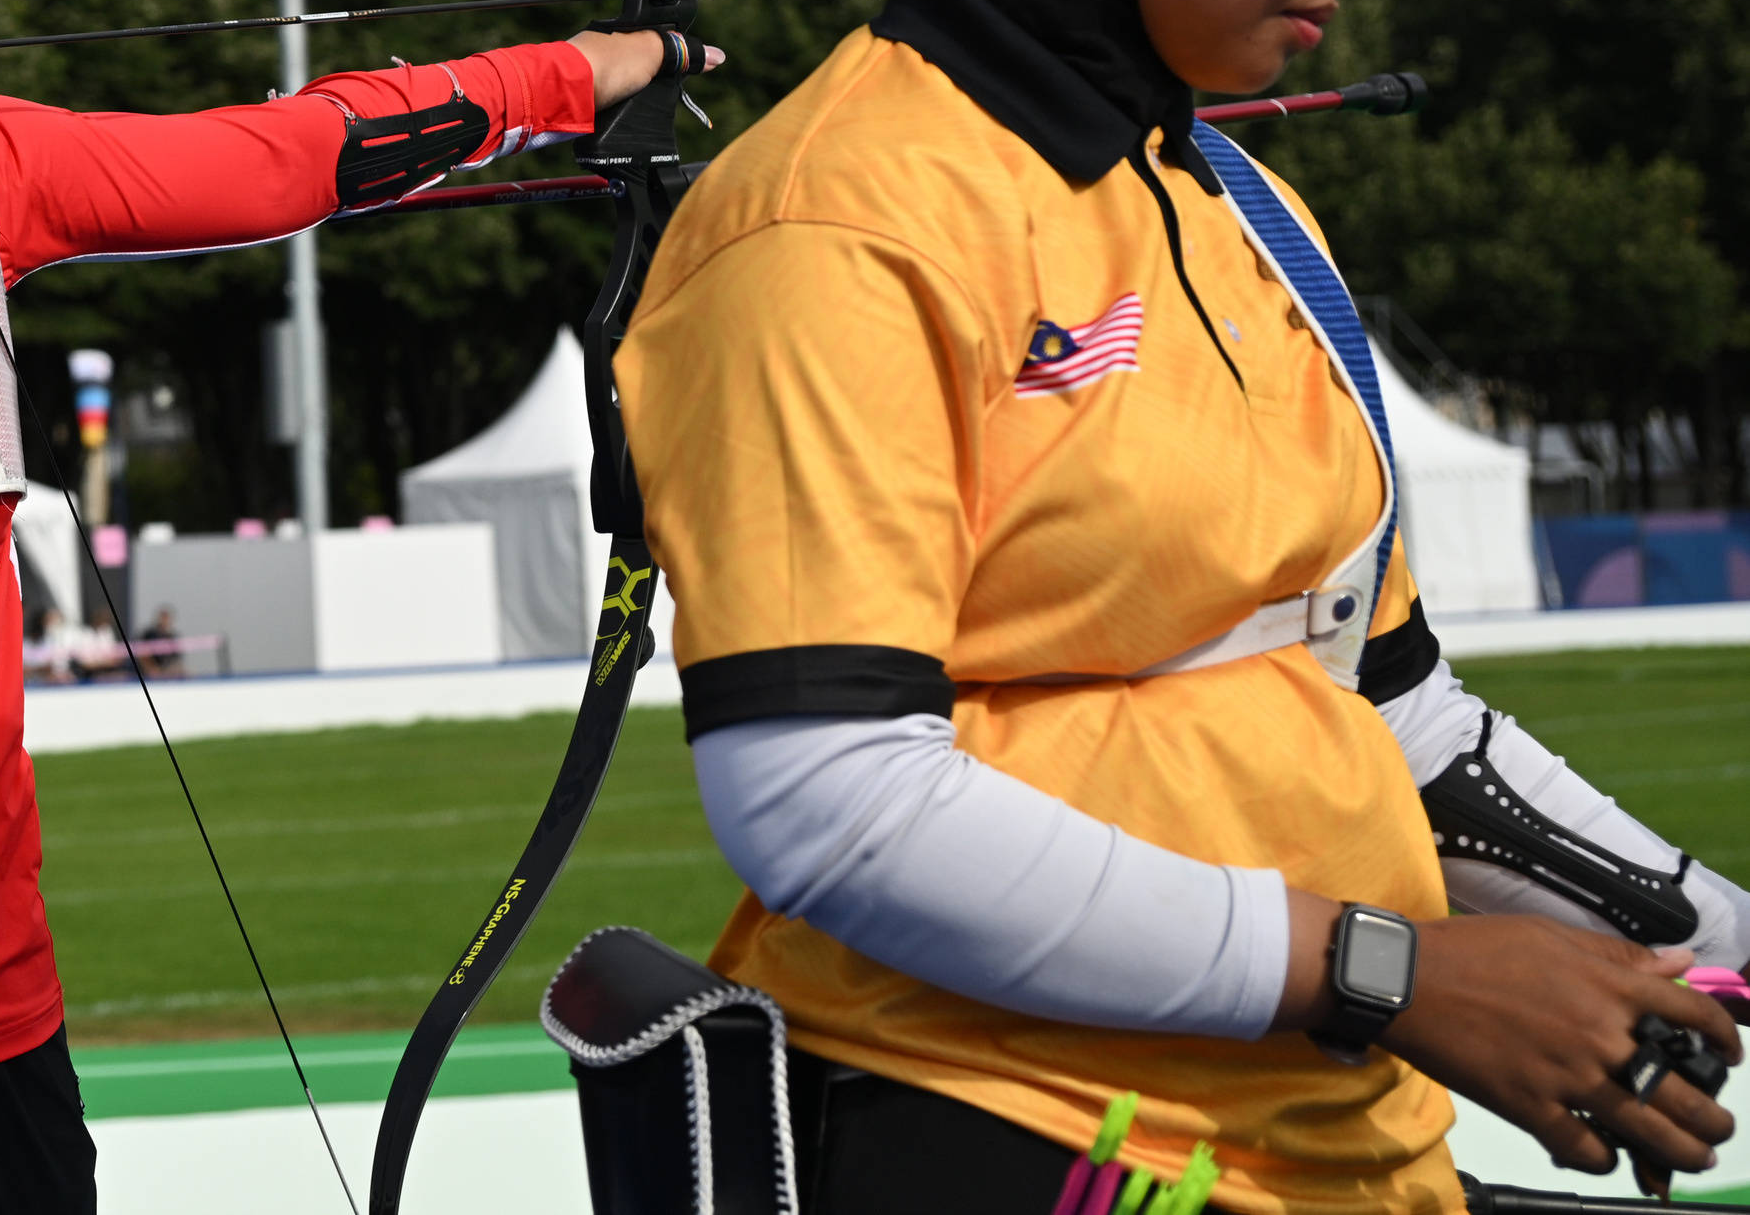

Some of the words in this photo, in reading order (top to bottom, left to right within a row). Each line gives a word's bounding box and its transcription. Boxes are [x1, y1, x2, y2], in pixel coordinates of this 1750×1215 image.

[609, 156, 633, 165] PERFLY
[595, 630, 632, 687] WIAWIS
[460, 878, 527, 968] NS-GRAPHENE
